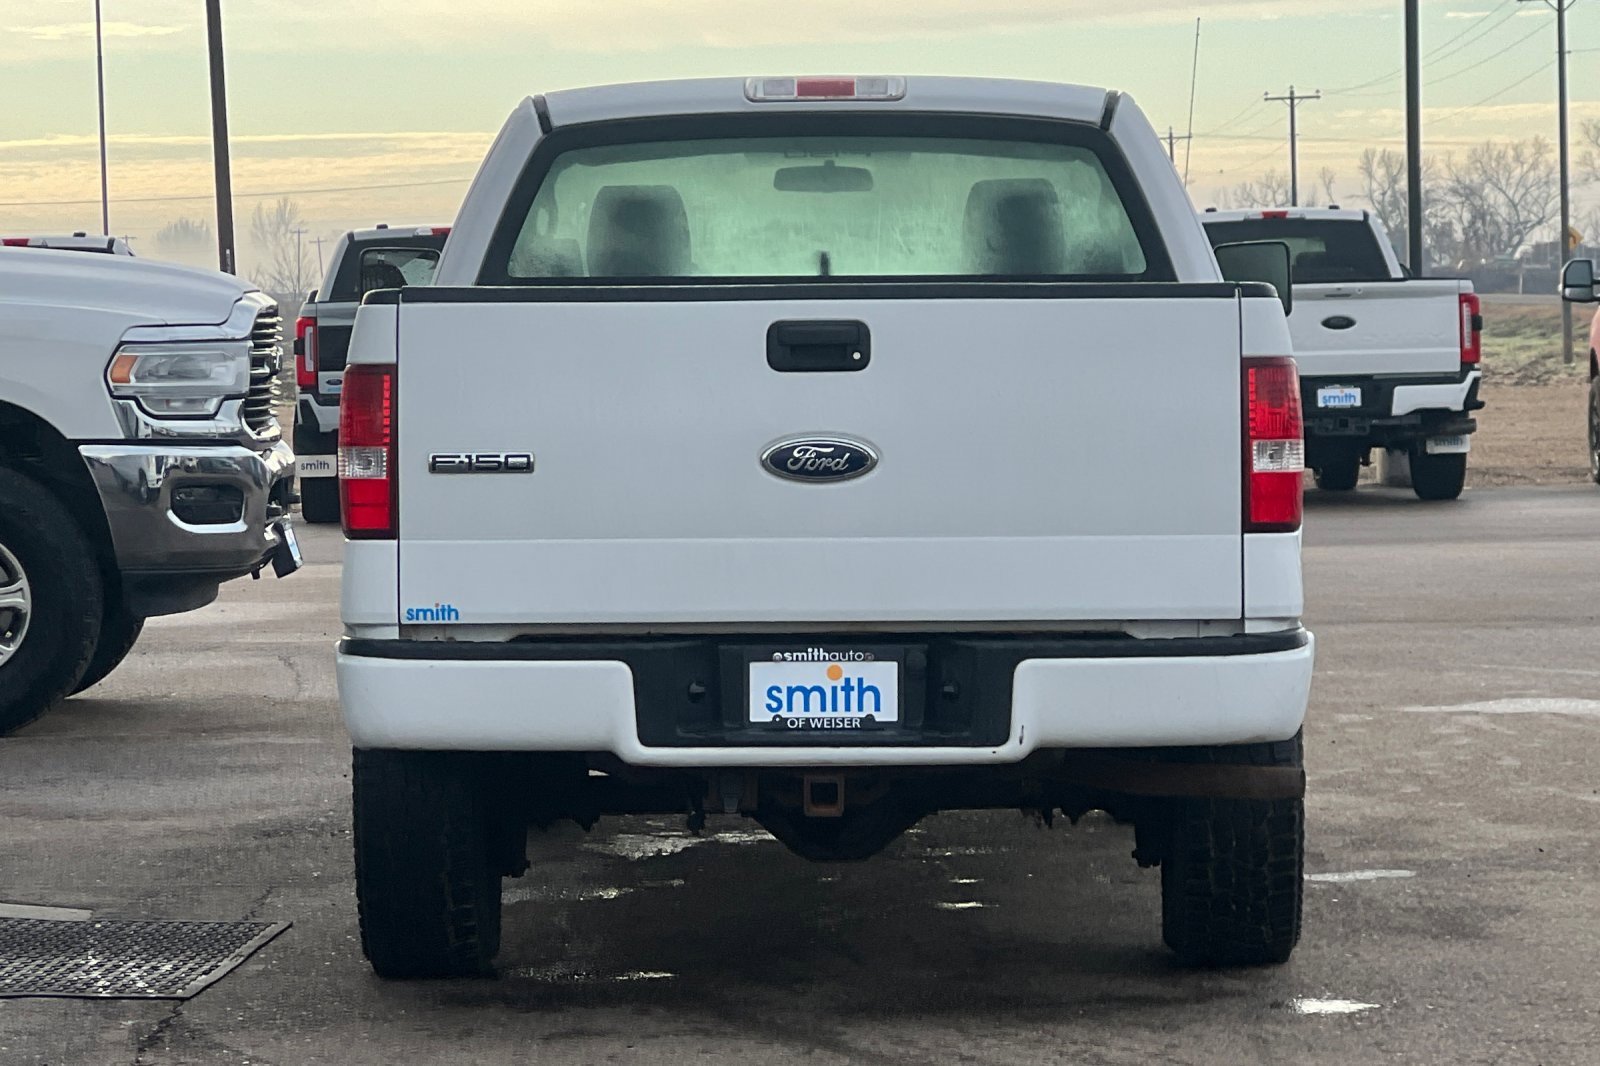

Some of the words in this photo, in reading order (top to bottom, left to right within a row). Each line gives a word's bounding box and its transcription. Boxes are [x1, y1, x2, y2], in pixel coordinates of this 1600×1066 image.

[1322, 390, 1356, 404] smith
[301, 460, 329, 470] smith
[787, 446, 850, 471] Ford
[406, 603, 459, 621] smith
[765, 664, 882, 714] smith
[787, 717, 806, 729] OF
[810, 717, 861, 729] WEISER
